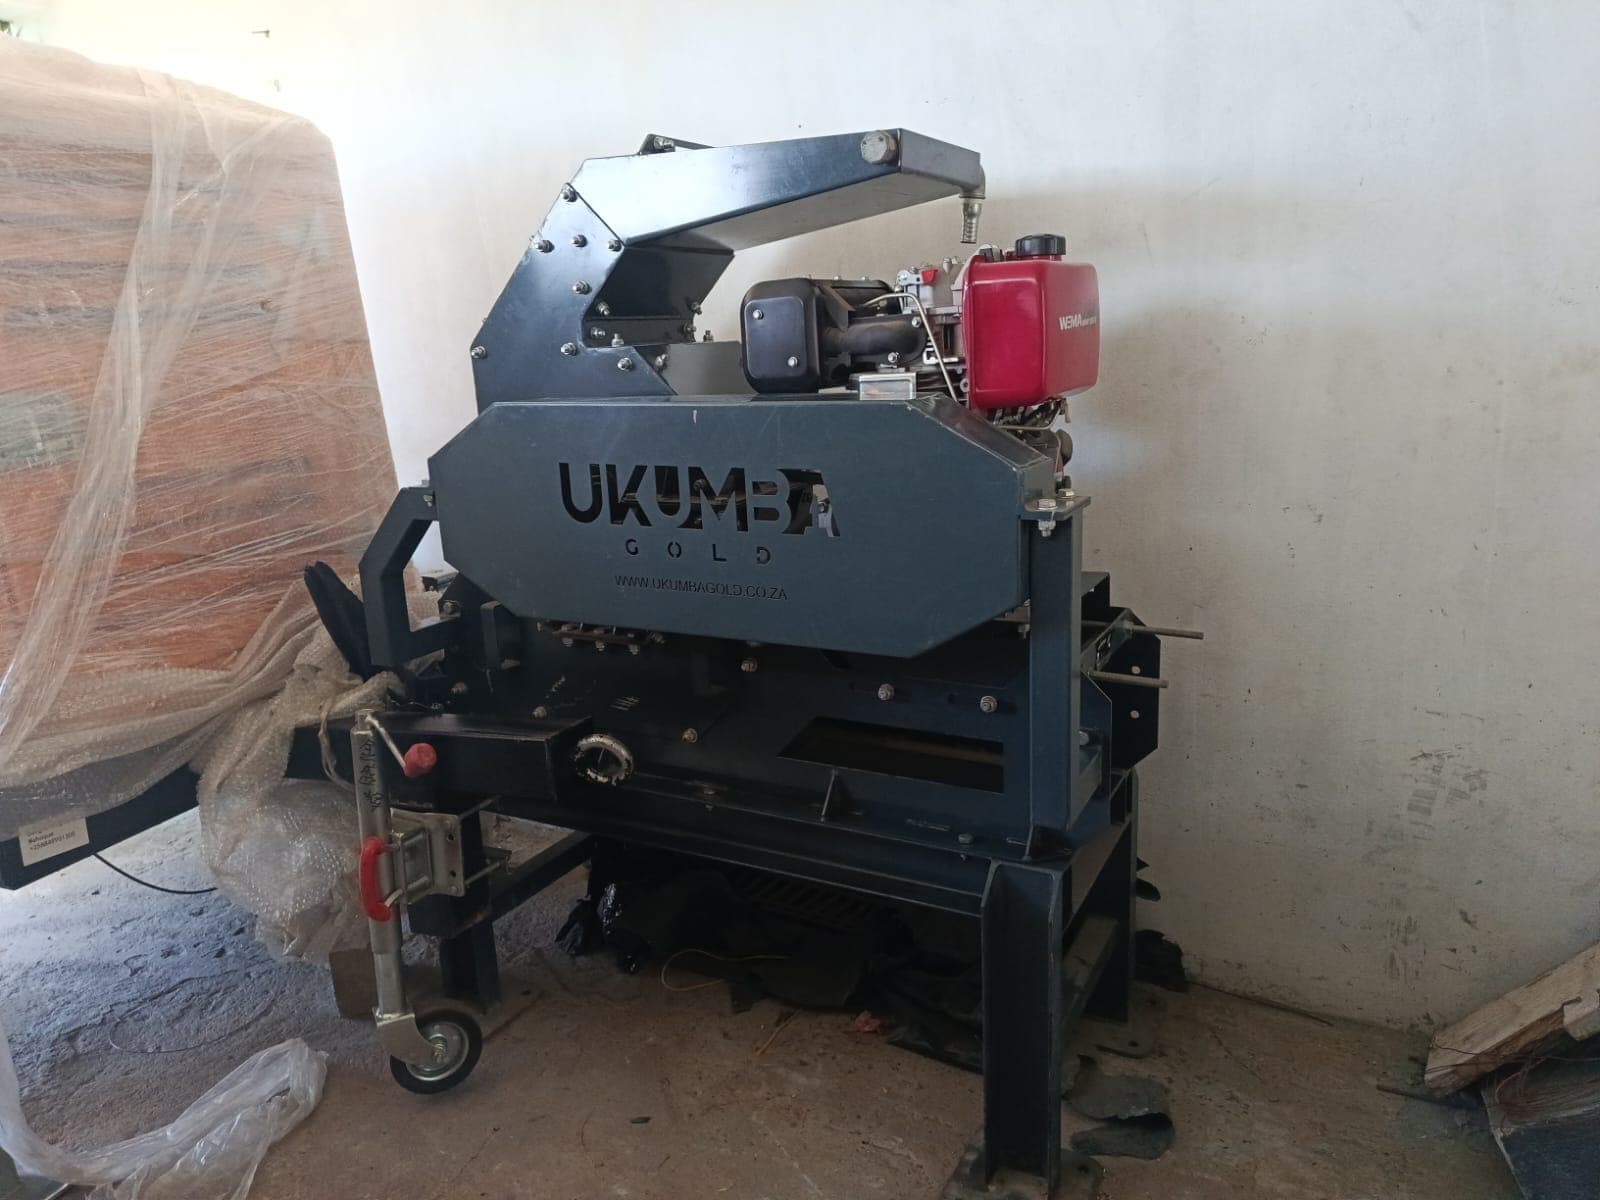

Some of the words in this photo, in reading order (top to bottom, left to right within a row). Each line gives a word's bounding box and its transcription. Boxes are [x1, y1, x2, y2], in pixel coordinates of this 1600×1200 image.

[558, 462, 840, 538] UKUMBA
[625, 538, 772, 565] GOLD
[614, 575, 788, 601] WWW.UKUMBAGOLD.CO.ZA
